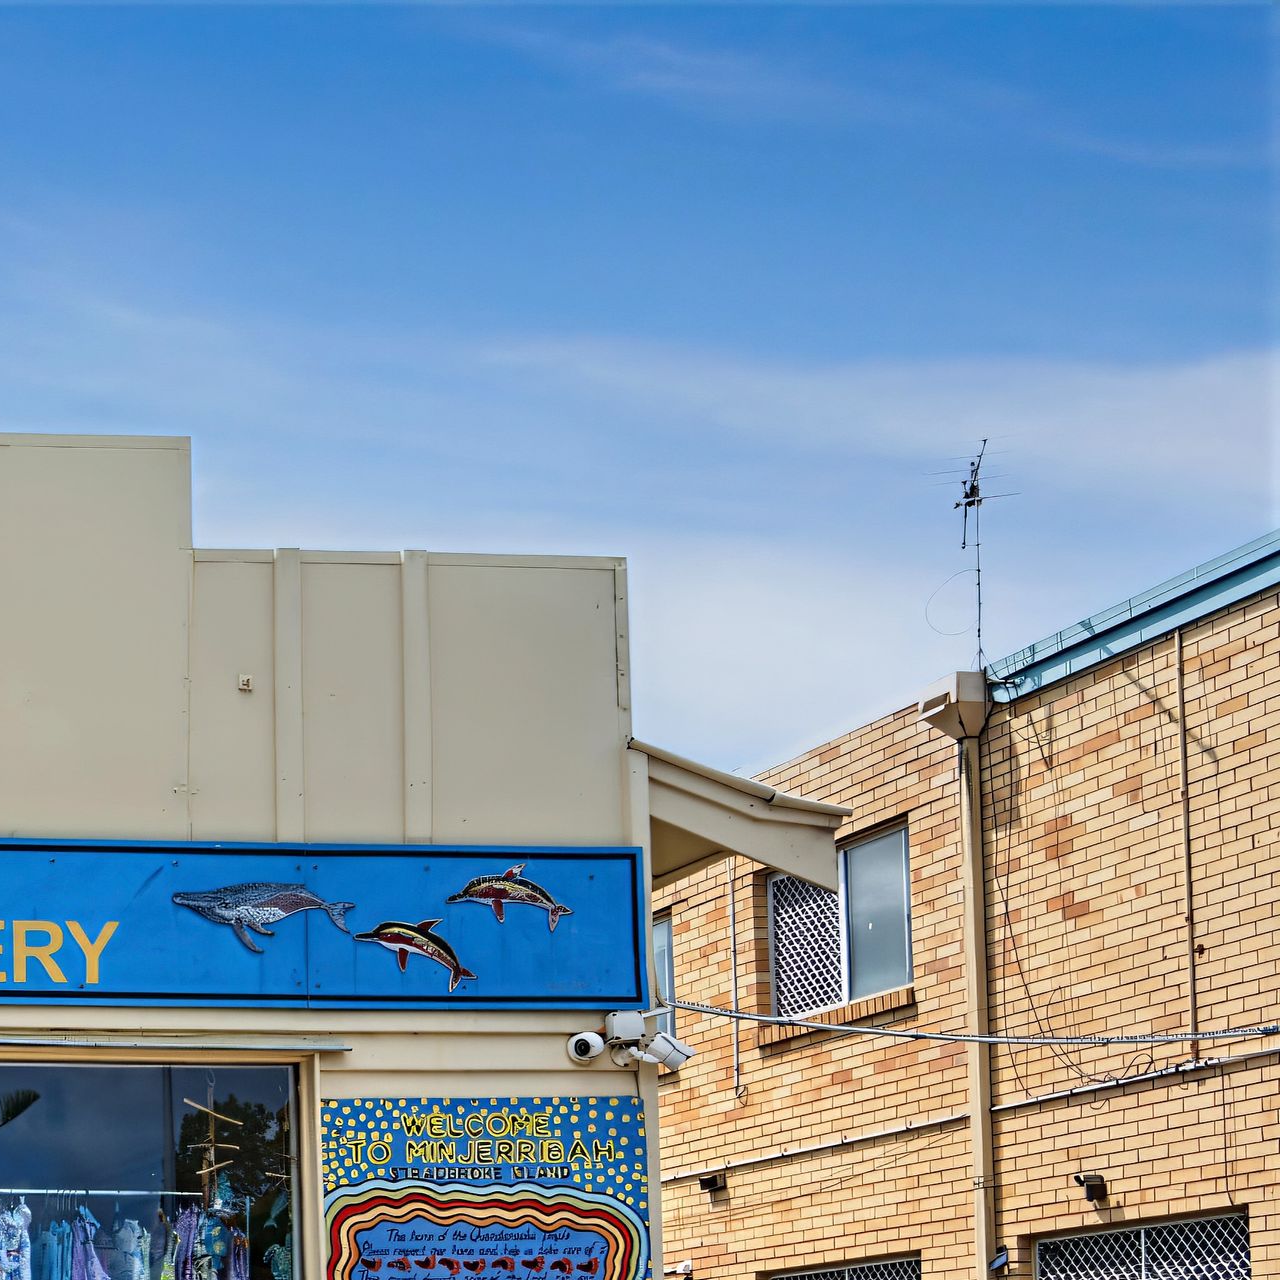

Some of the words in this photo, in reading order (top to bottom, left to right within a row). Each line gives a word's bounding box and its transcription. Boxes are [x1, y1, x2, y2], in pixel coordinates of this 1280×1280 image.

[401, 1111, 552, 1138] WELCOME
[347, 1139, 391, 1164] TO
[407, 1138, 615, 1165] MINJERRIBAH
